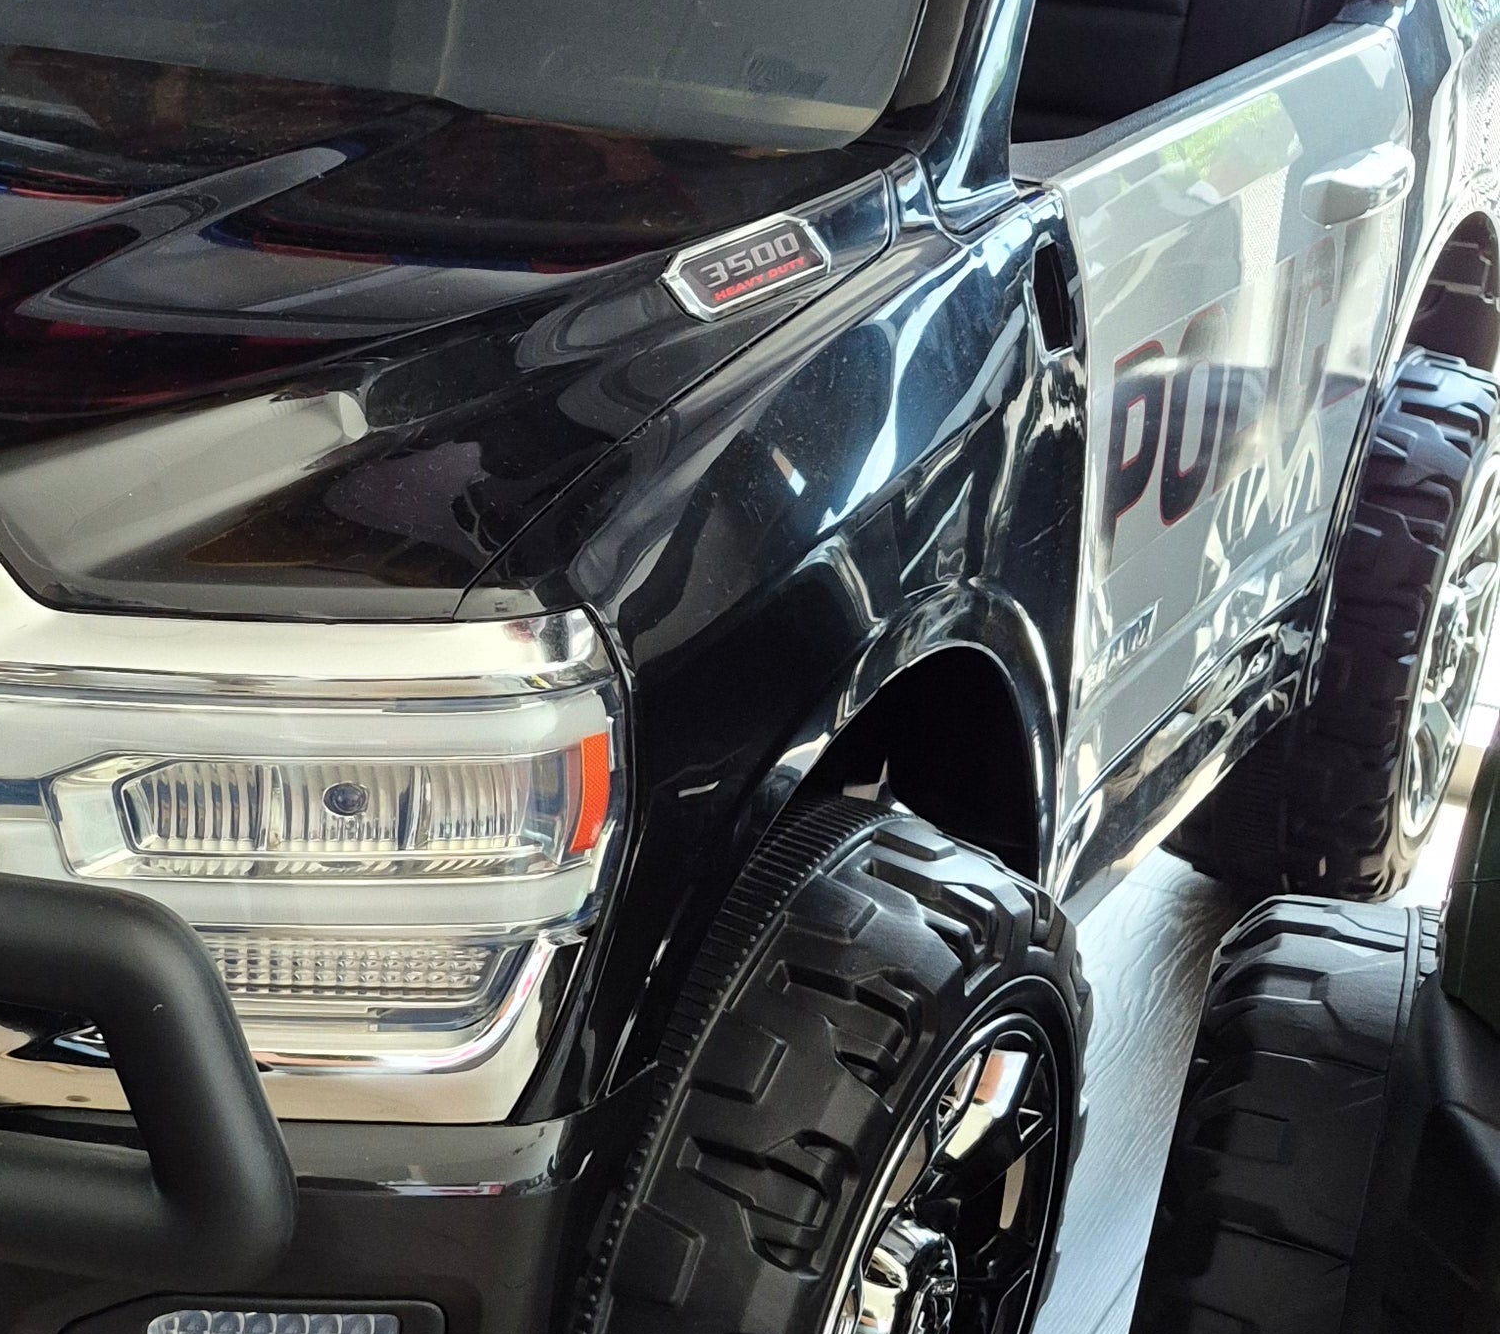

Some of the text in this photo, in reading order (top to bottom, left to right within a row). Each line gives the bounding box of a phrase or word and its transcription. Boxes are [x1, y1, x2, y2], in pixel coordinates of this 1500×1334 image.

[700, 232, 800, 288] 3500
[713, 256, 806, 302] HEAVY DUTY
